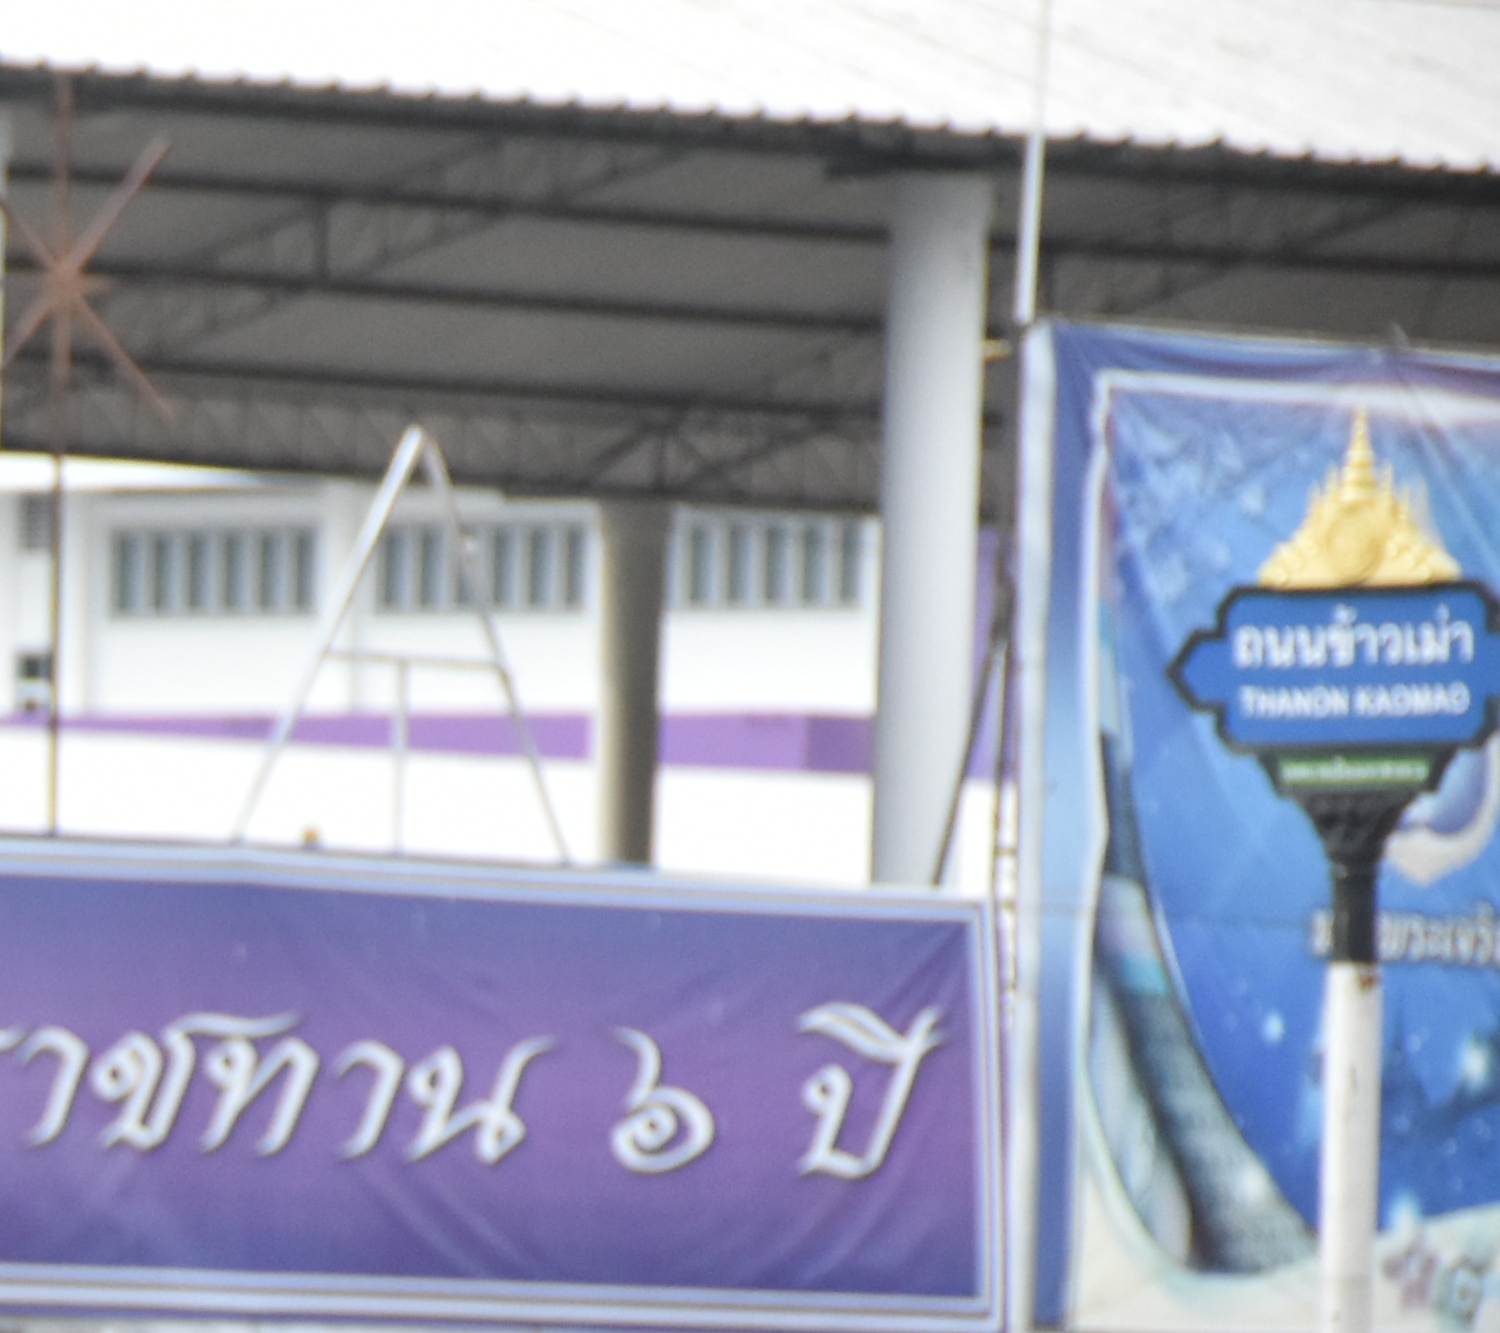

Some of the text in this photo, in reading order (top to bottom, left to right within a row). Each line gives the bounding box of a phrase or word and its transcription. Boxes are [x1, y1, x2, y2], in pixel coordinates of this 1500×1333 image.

[1233, 603, 1475, 669] ถนนข้าวเม่า
[1240, 682, 1471, 719] THANON KAOMAO
[610, 1025, 716, 1174] ๖
[797, 1000, 946, 1180] ปี
